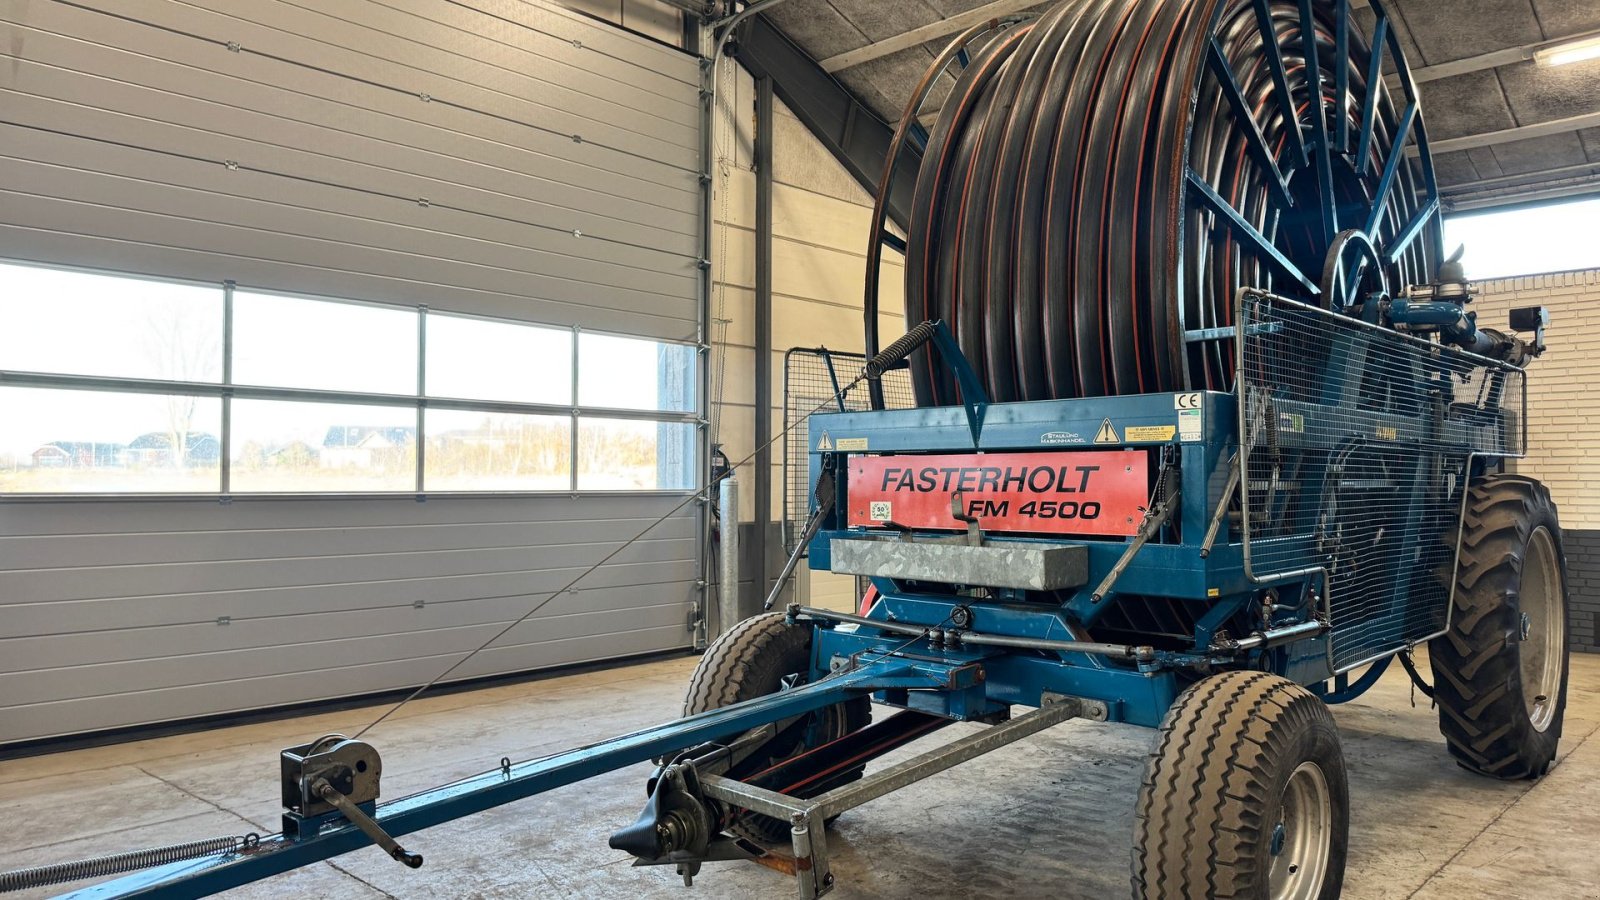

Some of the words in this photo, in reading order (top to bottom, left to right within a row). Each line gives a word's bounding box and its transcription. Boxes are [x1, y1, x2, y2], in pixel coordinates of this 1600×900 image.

[1178, 394, 1198, 408] CE
[881, 466, 1100, 493] FASTERHOLT
[968, 500, 1009, 518] FM
[1018, 501, 1101, 519] 4500
